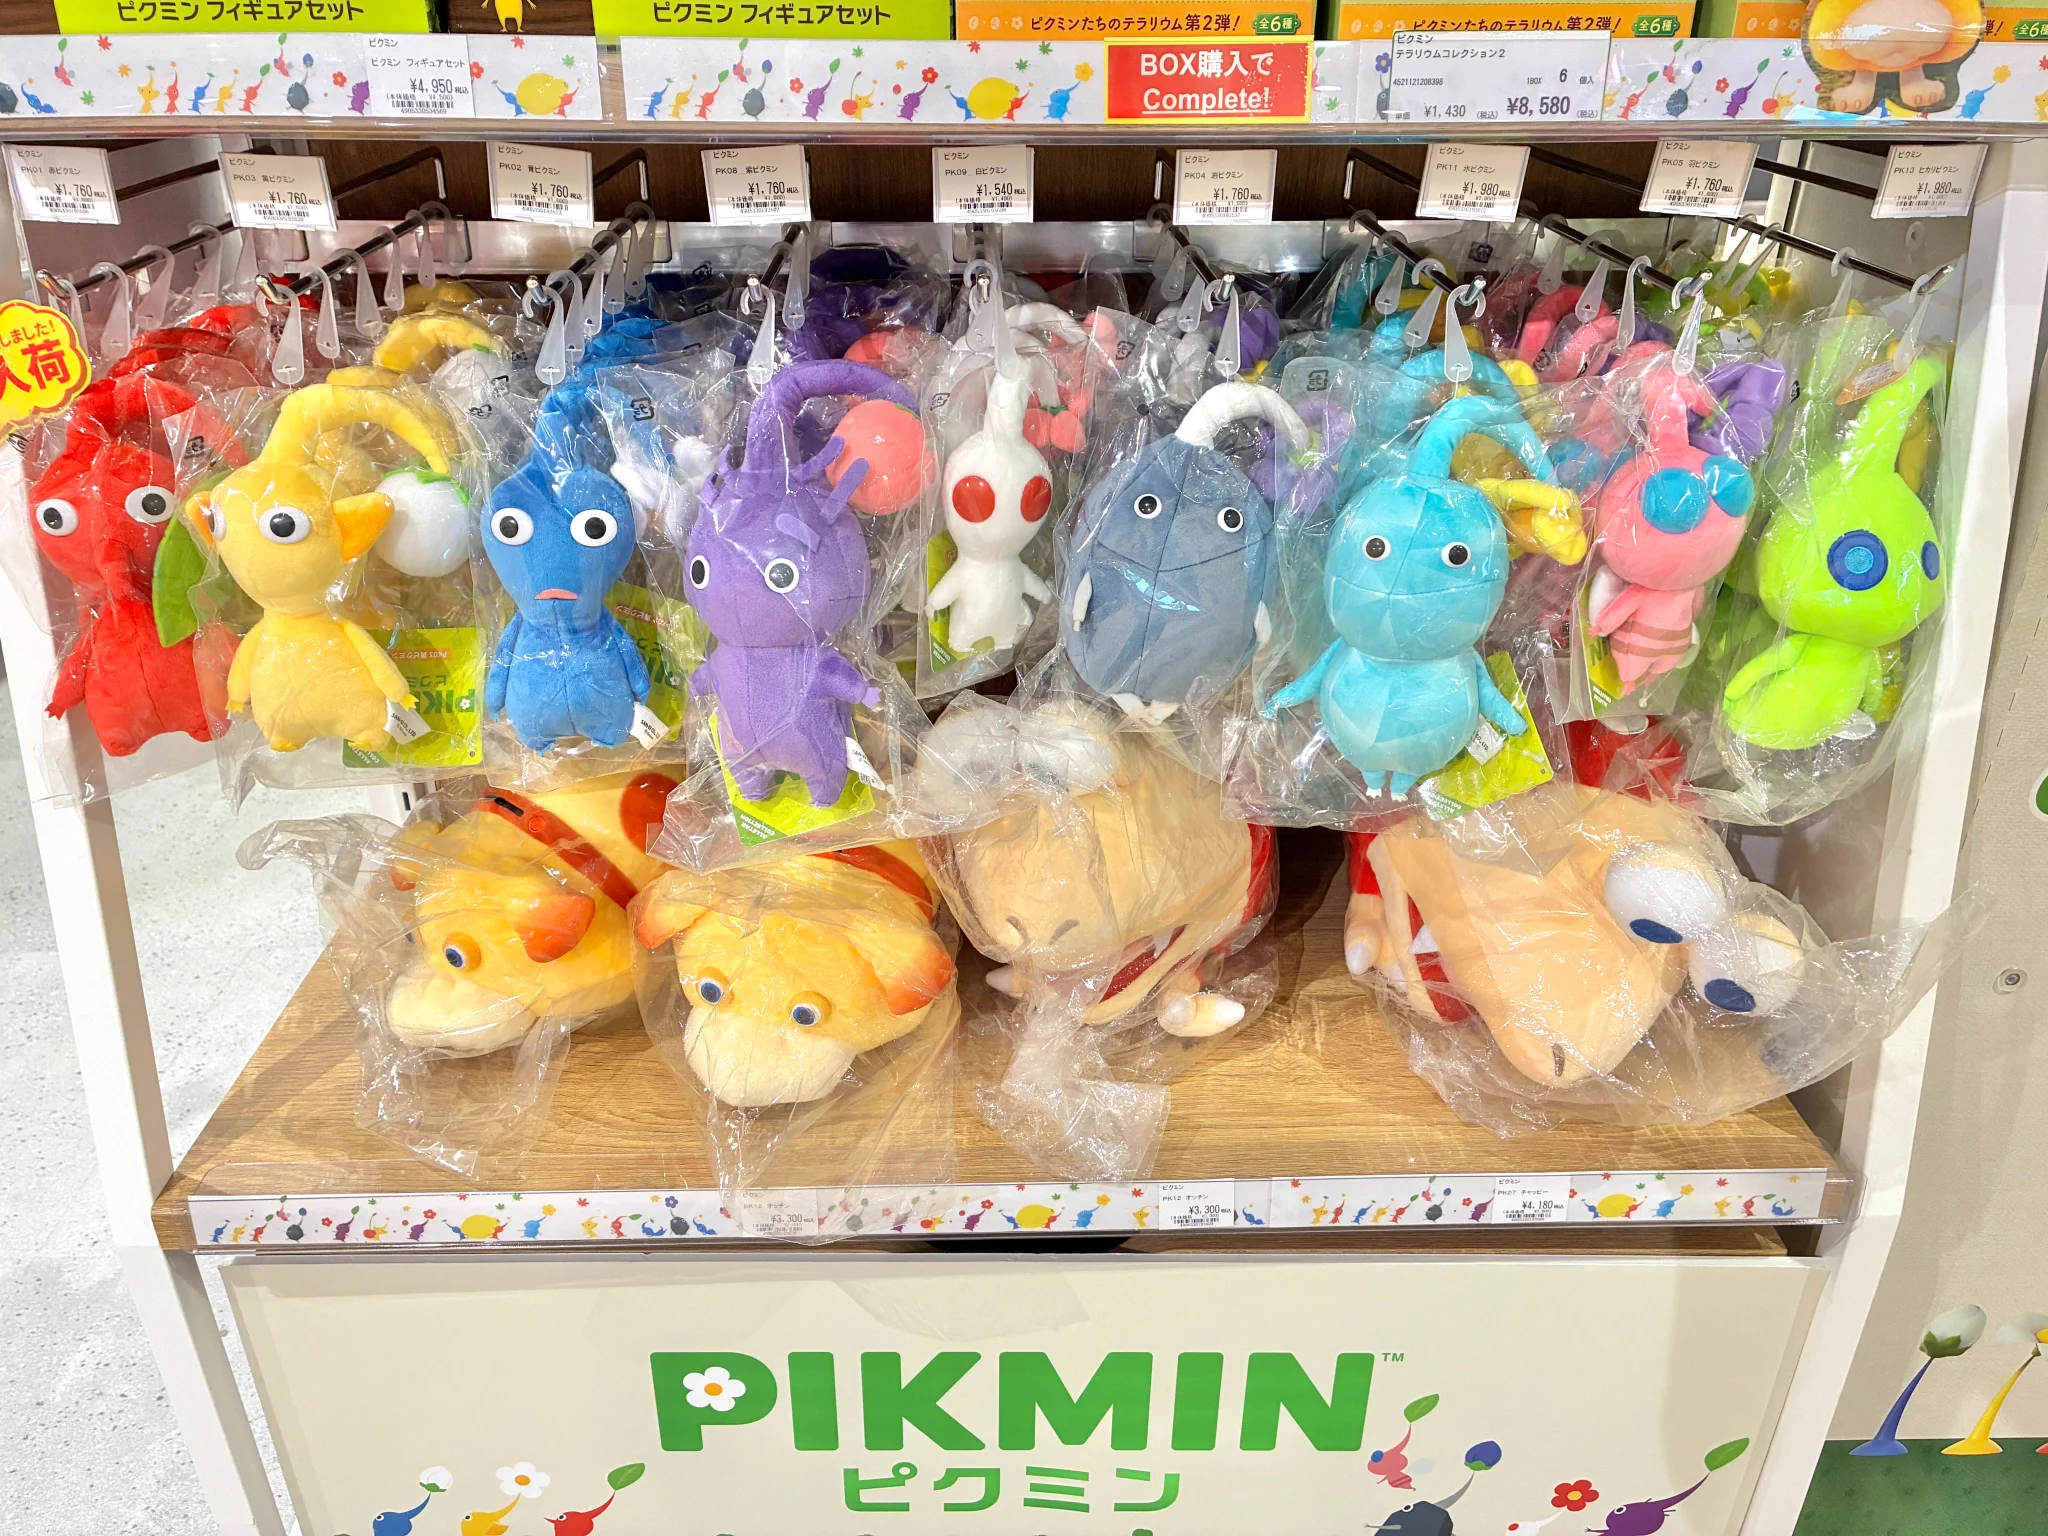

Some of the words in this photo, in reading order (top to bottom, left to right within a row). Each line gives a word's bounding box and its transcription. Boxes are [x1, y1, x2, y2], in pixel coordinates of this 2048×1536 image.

[118, 1, 199, 21] ピクミン
[207, 0, 364, 21] フィギュアセット
[653, 2, 732, 23] ピクミン
[743, 2, 891, 25] フィギュアセット
[1258, 15, 1293, 32] 全6種
[1638, 17, 1673, 34] 全6種
[369, 38, 398, 47] ピクミン
[1396, 34, 1434, 44] ピクミン
[1395, 49, 1506, 59] テラリウムコレクション2
[371, 57, 400, 67] ピクミン
[406, 57, 466, 68] フィギュアセット
[1140, 51, 1275, 79] BOX購入で
[1392, 77, 1443, 86] 4521121208398
[1559, 68, 1568, 83] 6
[1579, 77, 1594, 85] 個入
[409, 78, 453, 94] ¥4,950
[1143, 87, 1271, 113] Complete!
[1423, 104, 1466, 119] ¥1,430
[1506, 96, 1571, 116] ¥8,580
[498, 146, 524, 155] ピクミン
[1439, 147, 1465, 155] ピクミン
[1665, 142, 1691, 150] ピクミン
[713, 151, 739, 159] ピクミン
[944, 152, 969, 160] ピクミン
[1184, 155, 1210, 164] ピクミン
[1898, 151, 1922, 159] ピクミン
[499, 163, 522, 171] PK02
[1661, 159, 1684, 167] PK05
[945, 168, 967, 176] PK09
[975, 166, 1007, 175] 白ピクミン
[1894, 166, 1915, 174] PK13
[748, 181, 785, 196] ¥1,760
[976, 183, 1013, 196] ¥1,540
[1463, 181, 1499, 196] ¥1,980
[1686, 176, 1722, 191] ¥1,760
[1917, 182, 1952, 194] ¥1,980
[55, 183, 93, 197] ¥1,760
[531, 182, 569, 198] ¥1,760
[1213, 187, 1250, 200] ¥1,760
[269, 191, 307, 205] ¥1,760
[411, 688, 476, 715] PIK
[1188, 1205, 1220, 1215] ¥3,300
[1522, 1200, 1554, 1210] ¥4,180
[770, 1213, 803, 1223] ¥3,300
[649, 1352, 1375, 1452] PIKMIN
[843, 1461, 1180, 1514] ピクミン
